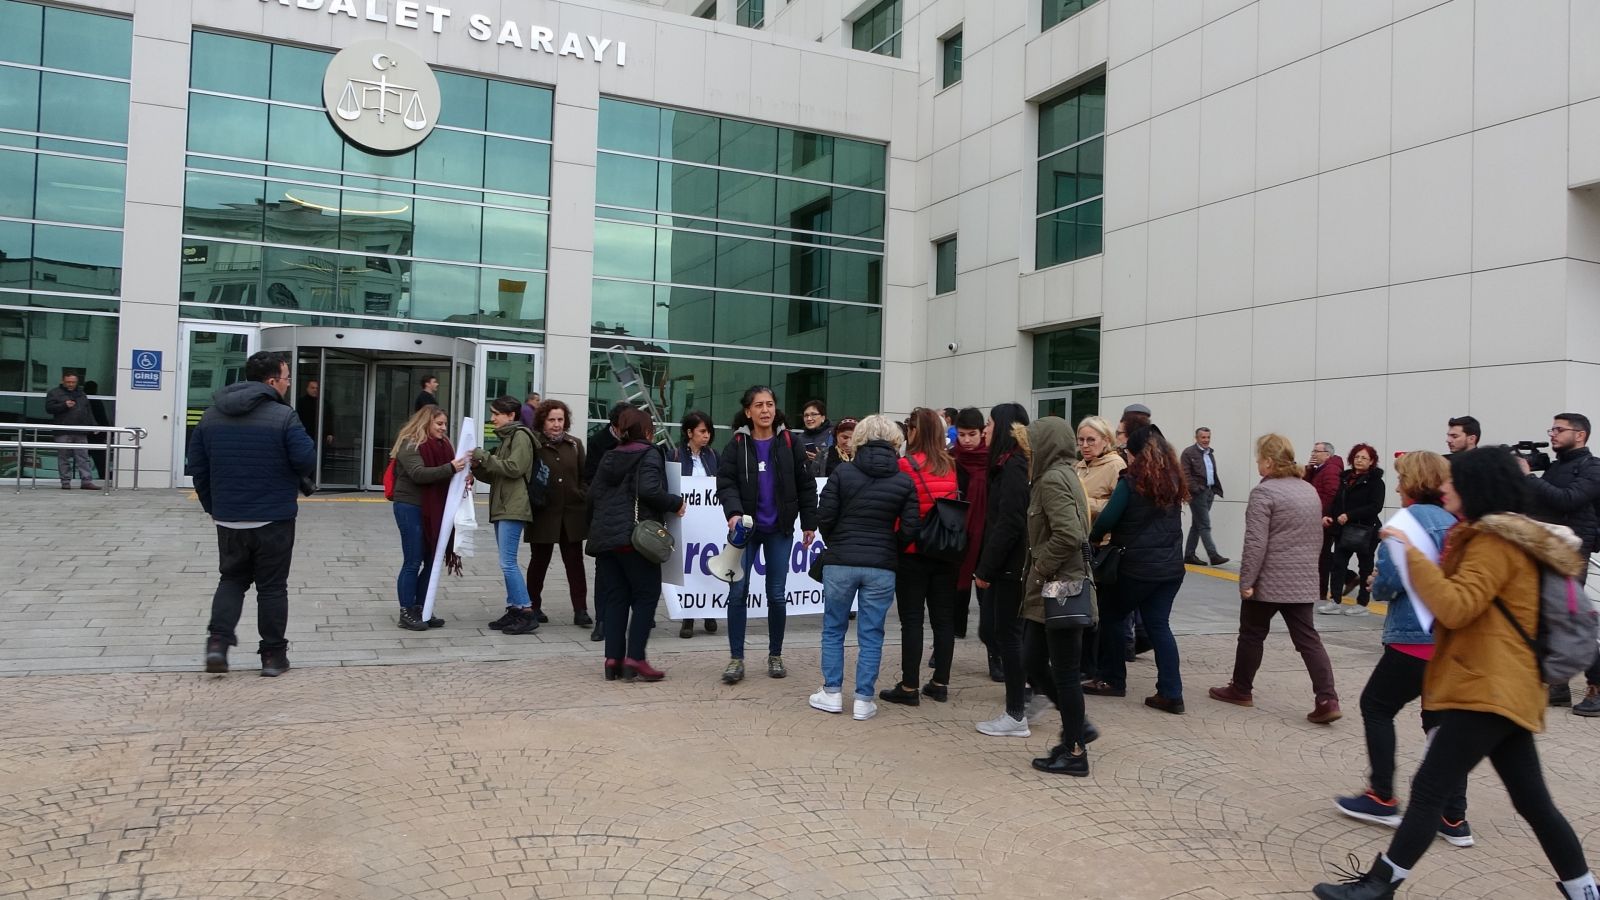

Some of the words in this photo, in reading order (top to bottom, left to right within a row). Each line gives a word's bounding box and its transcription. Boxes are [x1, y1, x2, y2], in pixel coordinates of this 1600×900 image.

[468, 13, 626, 66] SARAYI
[705, 488, 721, 506] Ko
[677, 593, 706, 609] RDU
